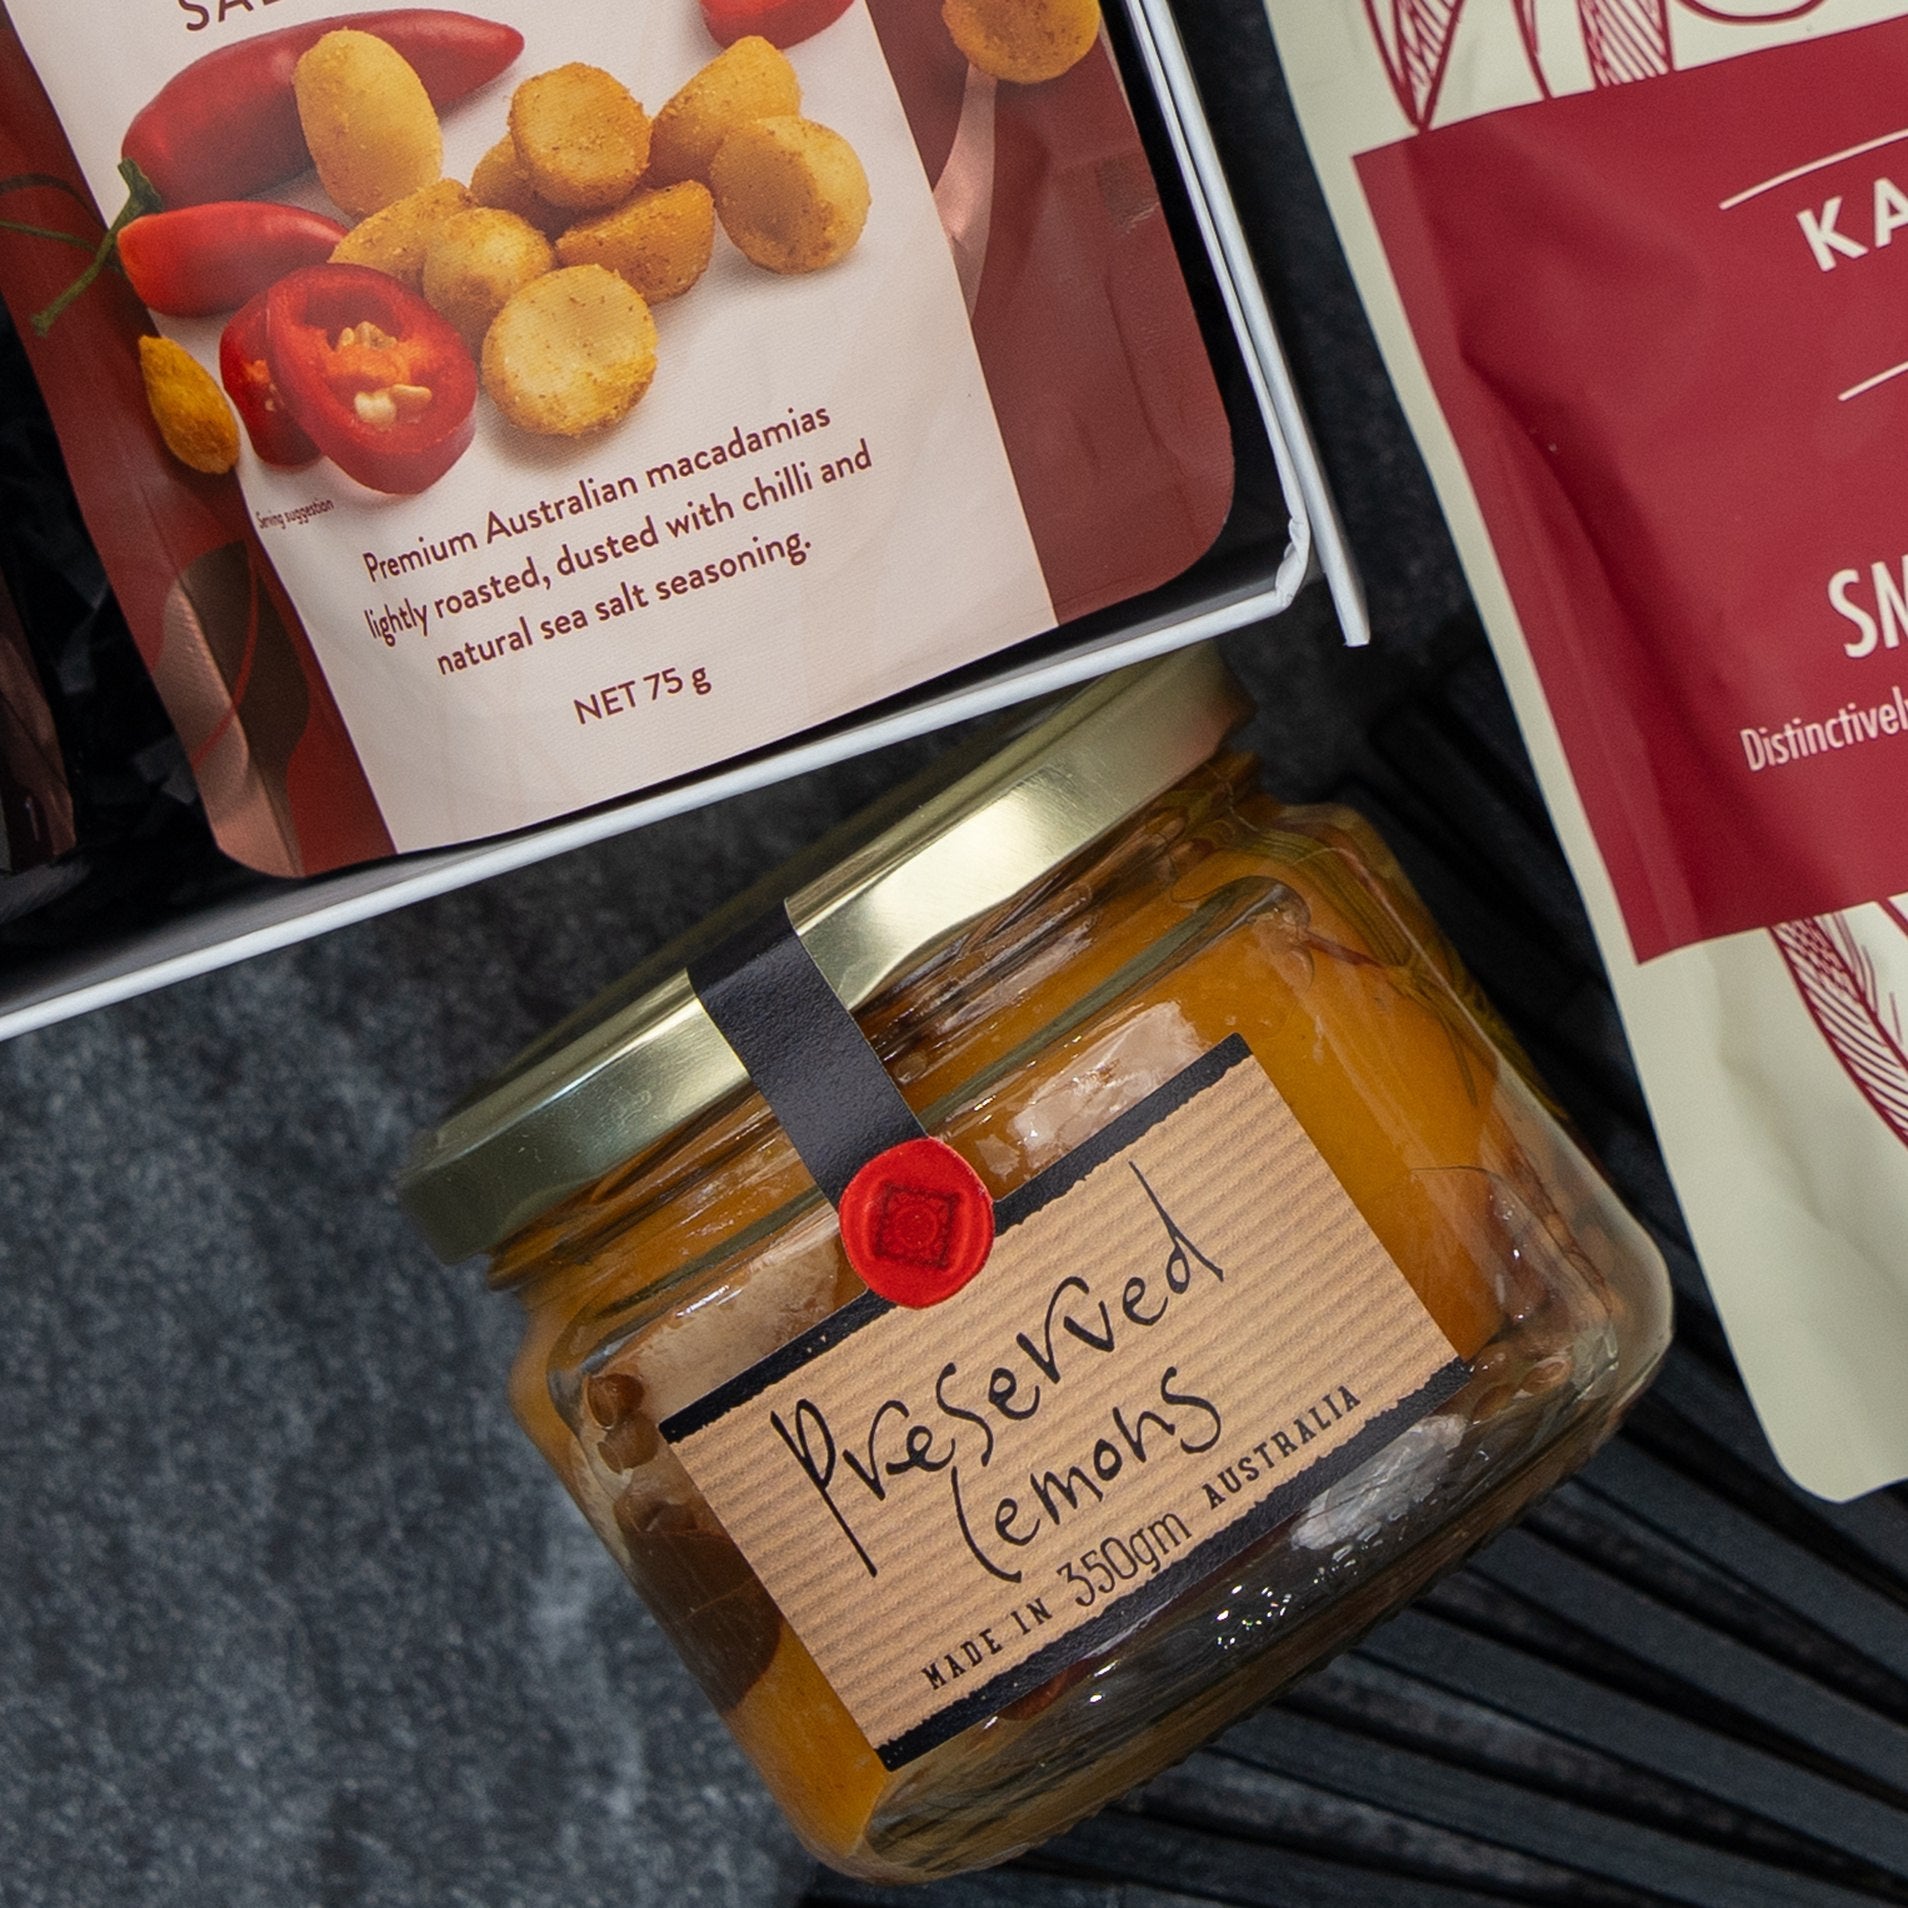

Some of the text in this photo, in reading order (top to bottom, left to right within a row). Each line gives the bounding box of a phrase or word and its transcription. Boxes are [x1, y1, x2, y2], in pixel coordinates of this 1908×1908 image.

[284, 497, 335, 525] suggestion
[362, 407, 831, 583] Premium Australian macadamias
[364, 437, 873, 648] lightly roasted, dusted with chilli and
[437, 533, 812, 676] natural sea salt seasoning.
[573, 666, 713, 726] NET 75 g
[1740, 685, 1908, 772] Distinctivel
[921, 1385, 1361, 1690] MADE IN 350gm AUSTRALIA
